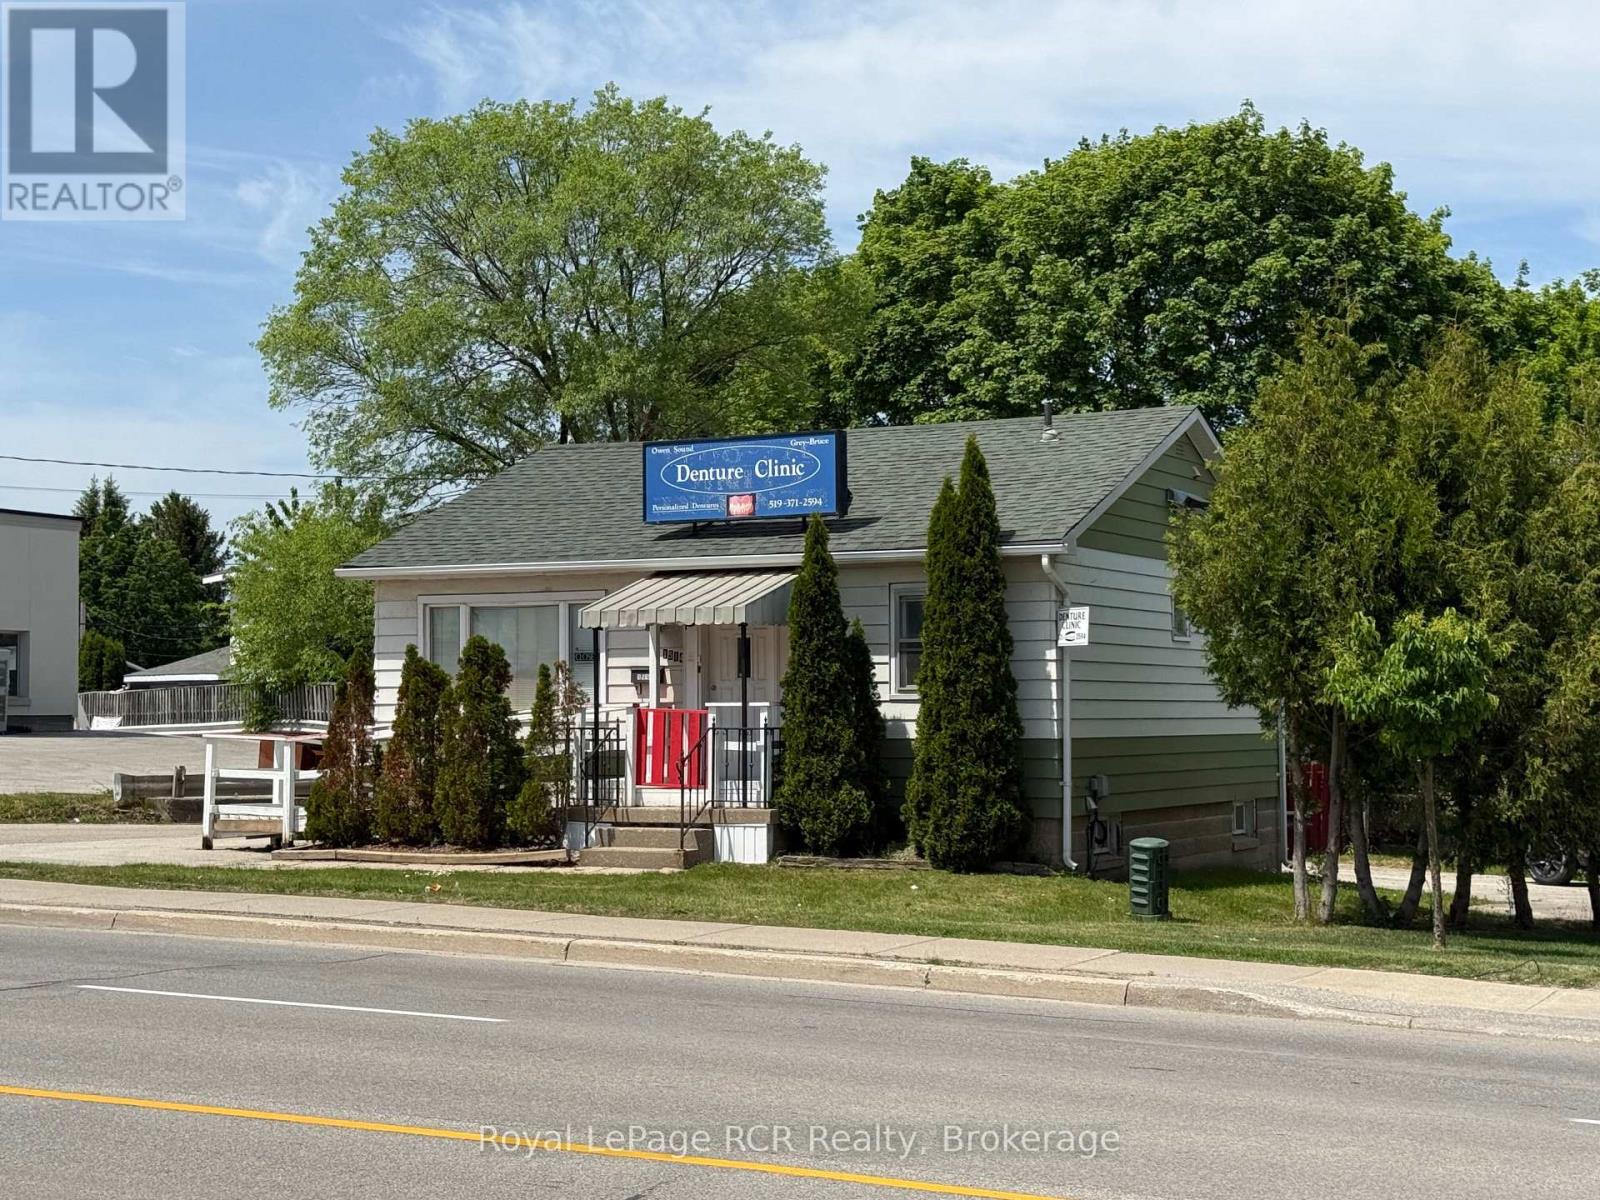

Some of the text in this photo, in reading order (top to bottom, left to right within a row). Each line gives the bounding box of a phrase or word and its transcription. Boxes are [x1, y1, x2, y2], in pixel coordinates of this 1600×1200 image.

[790, 437, 830, 447] Grey-Bruce
[651, 444, 694, 455] Owen Sound
[676, 458, 805, 482] Denture Clinic
[768, 497, 823, 509] 519-371-2594
[1059, 612, 1085, 620] DENTURE
